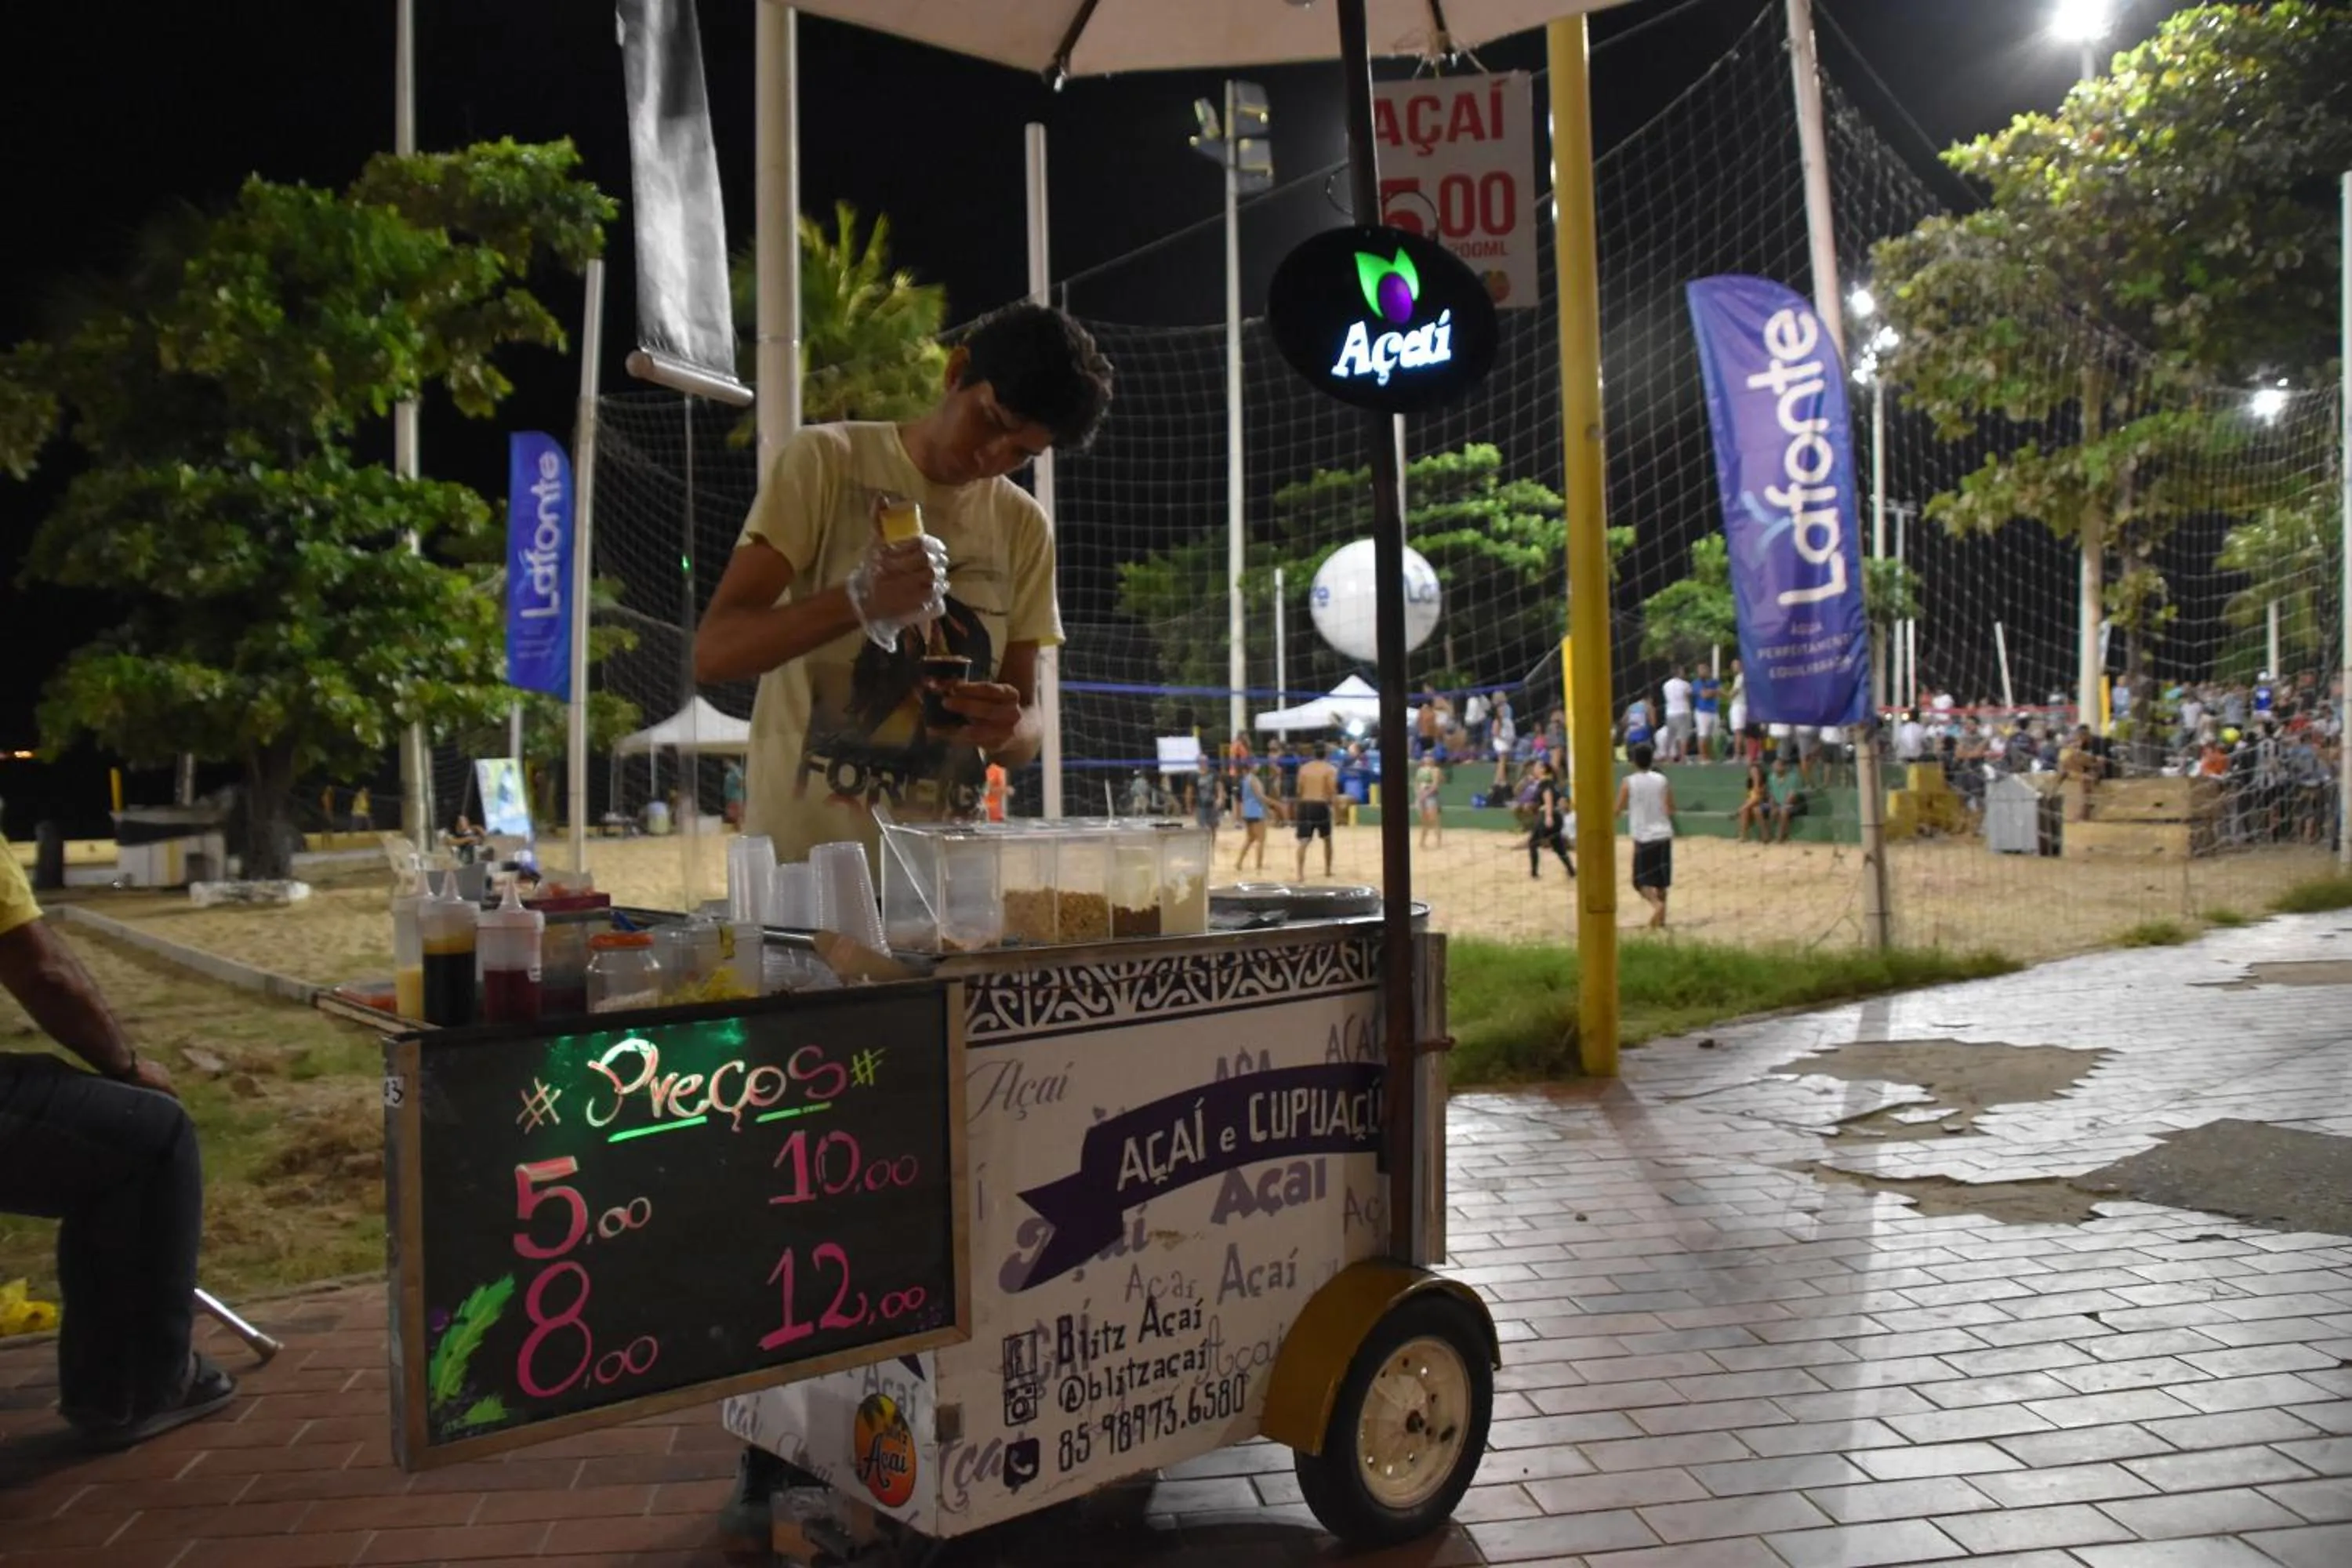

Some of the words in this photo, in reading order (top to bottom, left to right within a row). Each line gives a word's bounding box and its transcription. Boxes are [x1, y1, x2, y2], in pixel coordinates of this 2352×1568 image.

[1374, 78, 1507, 155] AÇAÍ
[1331, 309, 1452, 385] Açaí
[1747, 308, 1847, 607] Lafonte
[521, 451, 561, 618] Lafonte
[1117, 1098, 1205, 1192] AÇAÍ
[1219, 1126, 1237, 1152] e
[757, 1242, 927, 1352] 12,00
[1216, 1242, 1299, 1305] Açaí
[1138, 1296, 1204, 1342] Açaí
[1058, 1421, 1091, 1472] 85
